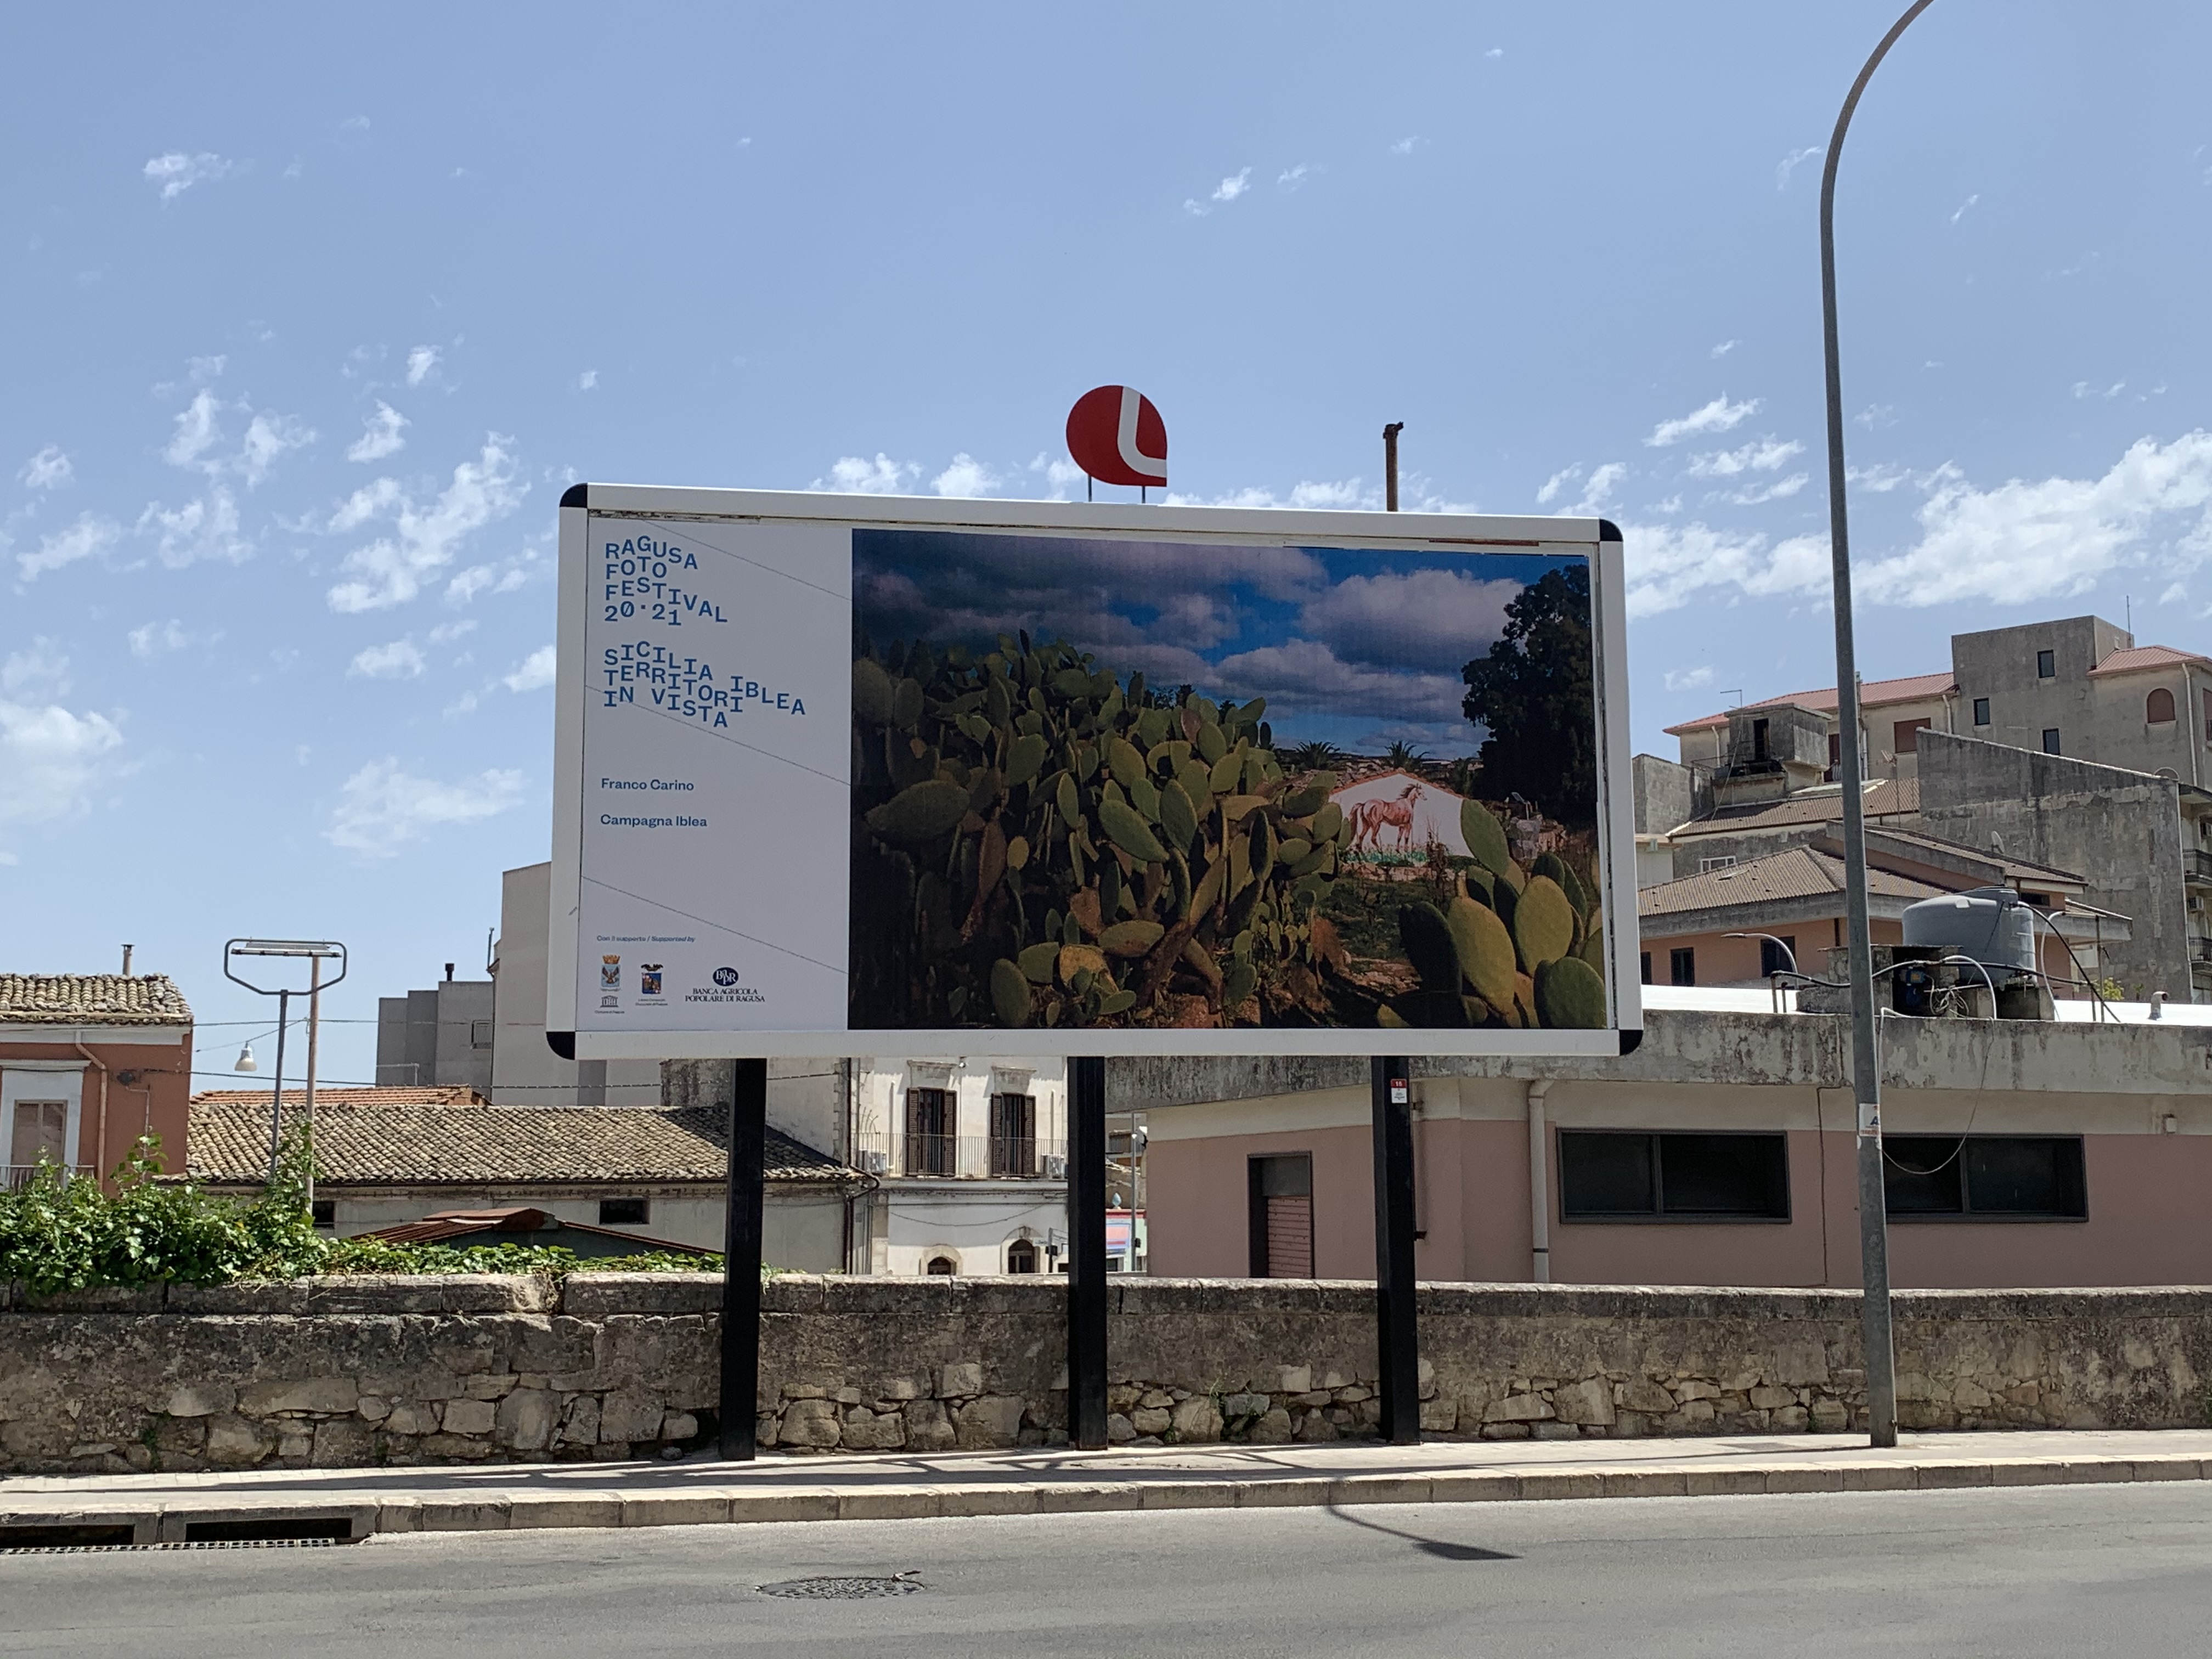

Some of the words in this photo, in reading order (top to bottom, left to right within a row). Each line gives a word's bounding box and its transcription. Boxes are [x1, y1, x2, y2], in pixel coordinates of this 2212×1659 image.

[605, 535, 698, 569] RAGUSA
[606, 556, 667, 579] FOTO
[606, 577, 727, 623] FESTIVAL
[604, 641, 713, 681] SICILIA
[730, 676, 805, 715] IBLEA
[604, 662, 743, 713] TERRITORI
[604, 686, 634, 707] IN
[651, 688, 728, 728] VISTA
[601, 778, 647, 789] Franco
[650, 779, 694, 791] Carino
[601, 814, 673, 828] Campagna
[676, 816, 707, 827] Iblea
